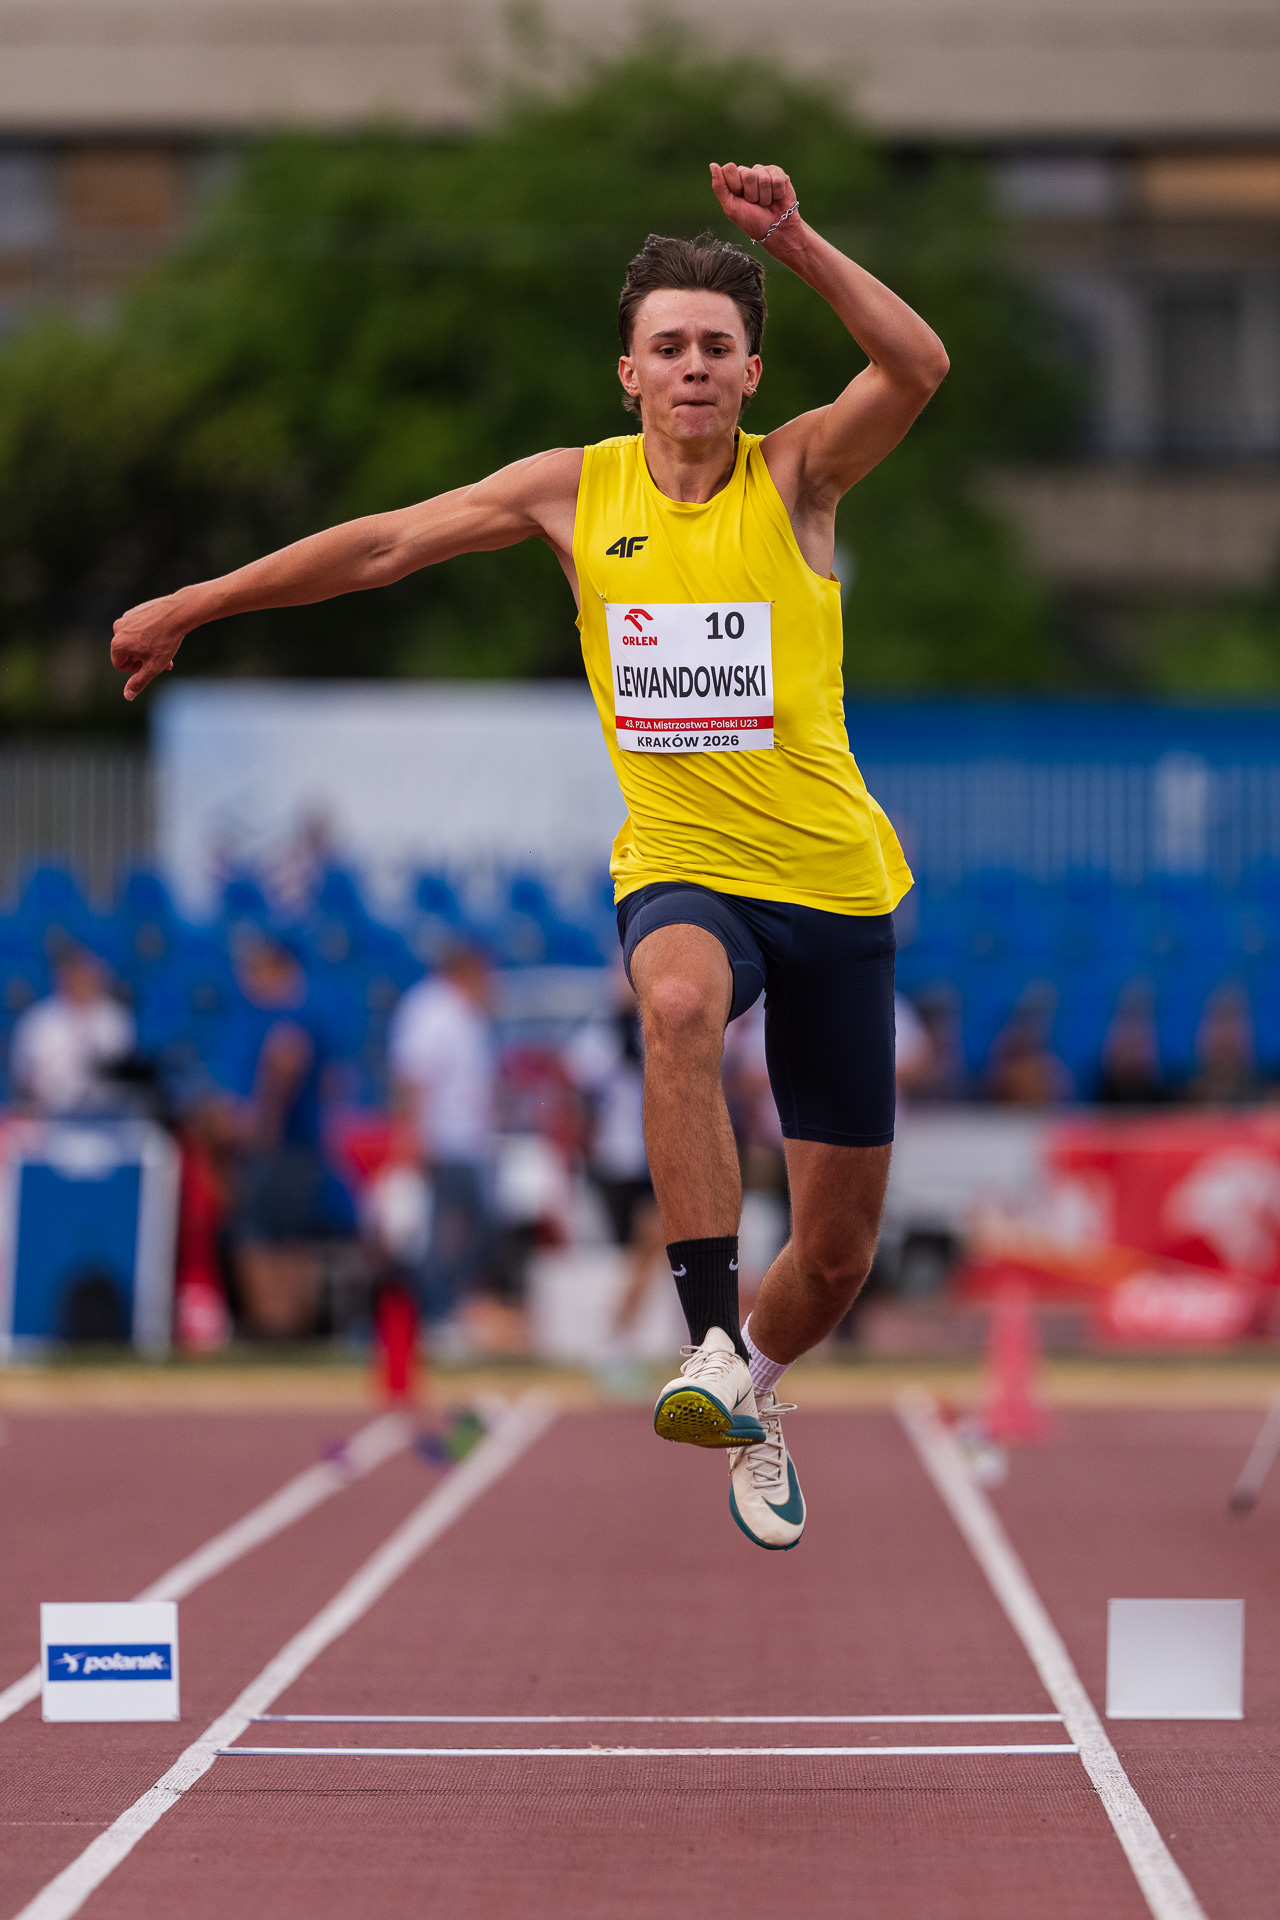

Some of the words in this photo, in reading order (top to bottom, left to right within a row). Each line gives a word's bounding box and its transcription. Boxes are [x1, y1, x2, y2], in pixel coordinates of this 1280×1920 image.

[606, 535, 649, 559] 4F
[705, 611, 745, 640] 10
[622, 636, 658, 646] ORLEN
[616, 665, 767, 699] LEWANDOWSKI
[625, 719, 635, 729] 43.
[635, 720, 652, 730] PZLA
[653, 720, 709, 730] Mistrzostwa
[711, 719, 738, 729] Polski
[740, 718, 758, 728] U23
[637, 733, 699, 748] KRAKÓW
[702, 735, 740, 747] 2026
[82, 1651, 165, 1675] polanik
